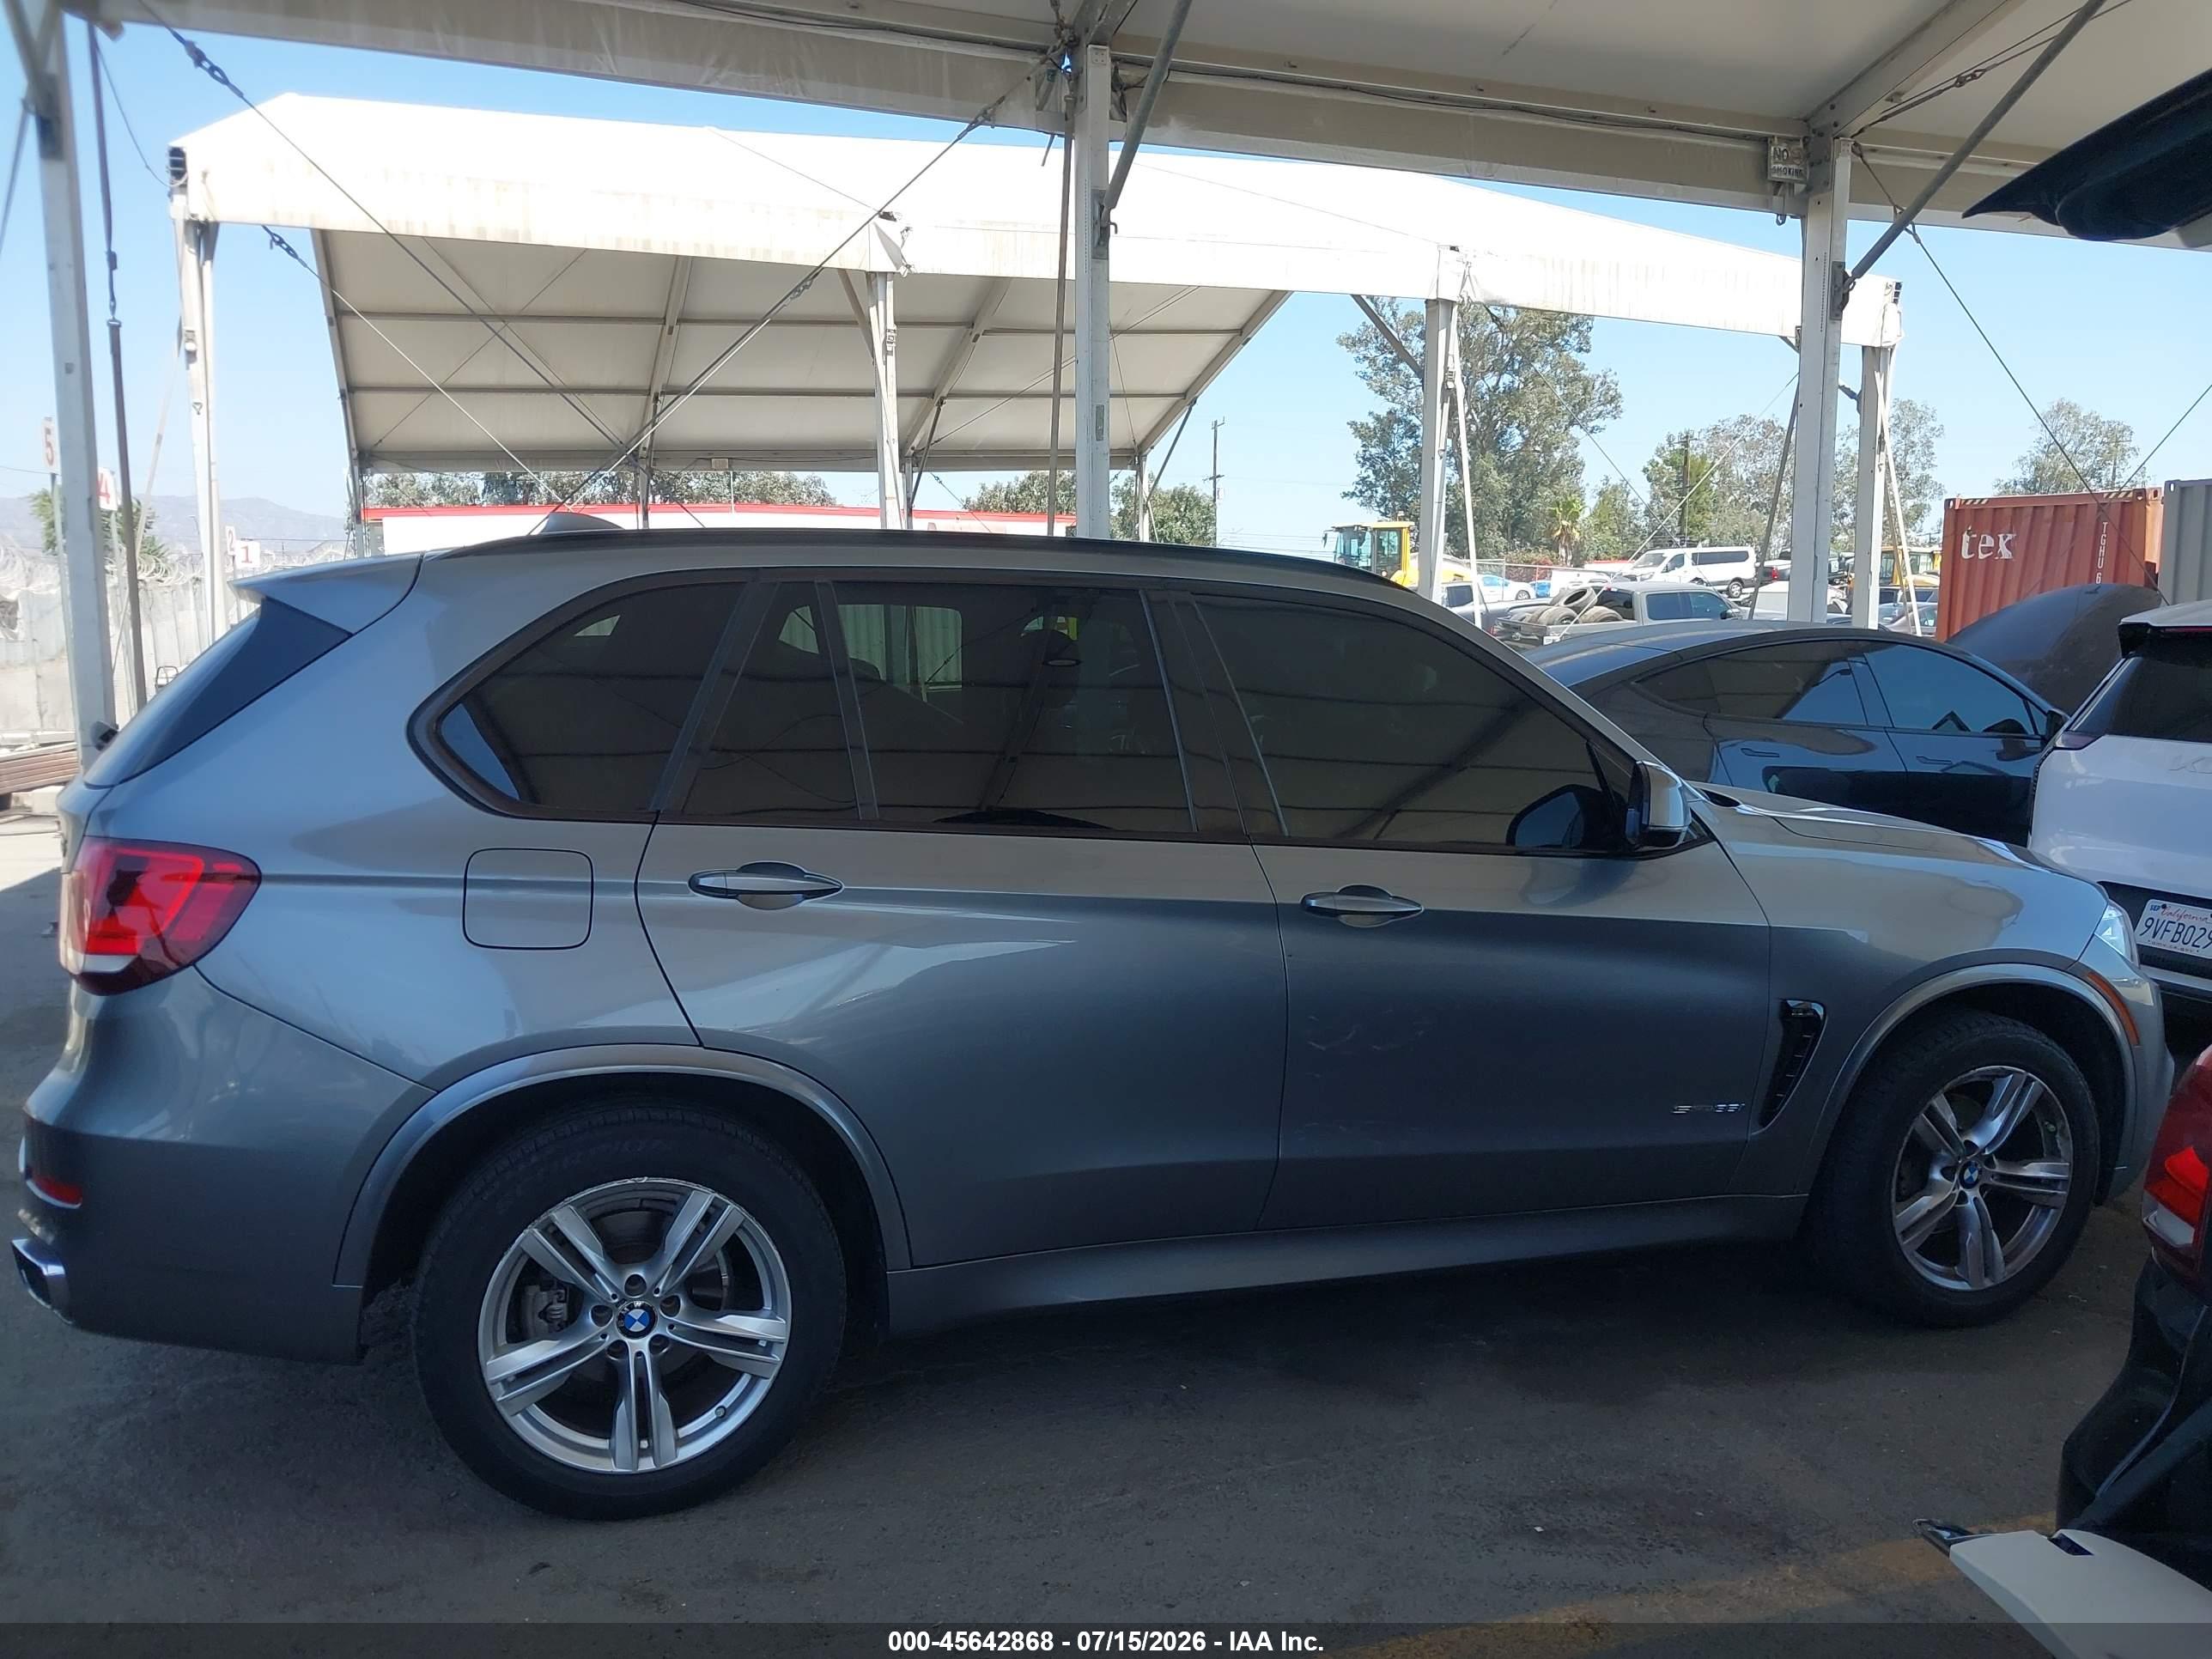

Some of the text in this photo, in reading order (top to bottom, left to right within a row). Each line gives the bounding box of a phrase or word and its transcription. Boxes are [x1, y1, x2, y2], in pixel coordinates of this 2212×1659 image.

[1772, 147, 1790, 161] NO
[44, 427, 55, 466] 5
[96, 472, 111, 505] 4
[240, 544, 253, 564] 1
[1961, 525, 2016, 559] tex
[2097, 521, 2108, 569] TGHU
[2139, 916, 2212, 950] 9VFB029
